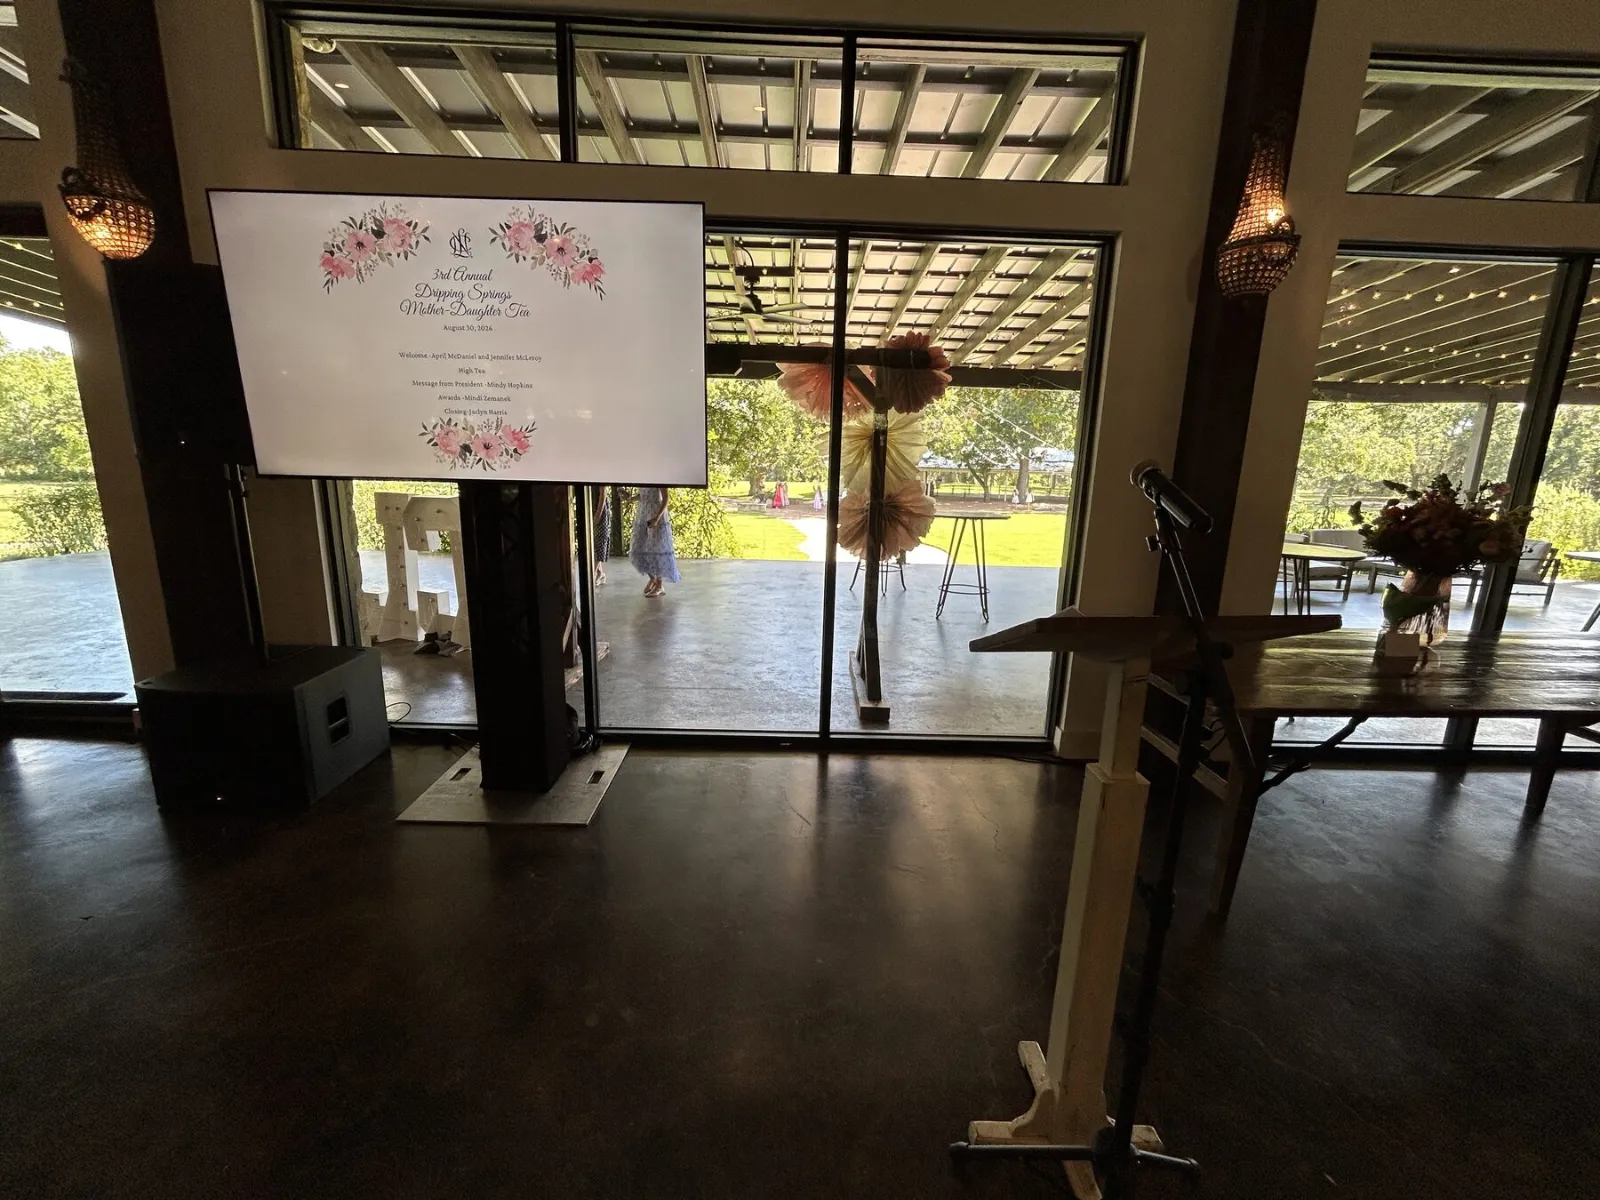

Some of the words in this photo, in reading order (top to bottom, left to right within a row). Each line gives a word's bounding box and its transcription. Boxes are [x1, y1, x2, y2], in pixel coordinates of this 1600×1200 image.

[432, 268, 451, 281] 3rd
[452, 266, 493, 281] Annual
[414, 282, 465, 302] Dripping
[467, 283, 512, 304] Springs
[399, 299, 502, 321] Mother-Daughter
[504, 302, 531, 318] Tea
[443, 324, 465, 332] August
[515, 355, 542, 363] McLeroy
[458, 367, 473, 375] High
[412, 380, 438, 388] Message
[455, 380, 483, 388] President
[508, 382, 533, 390] Hopkins
